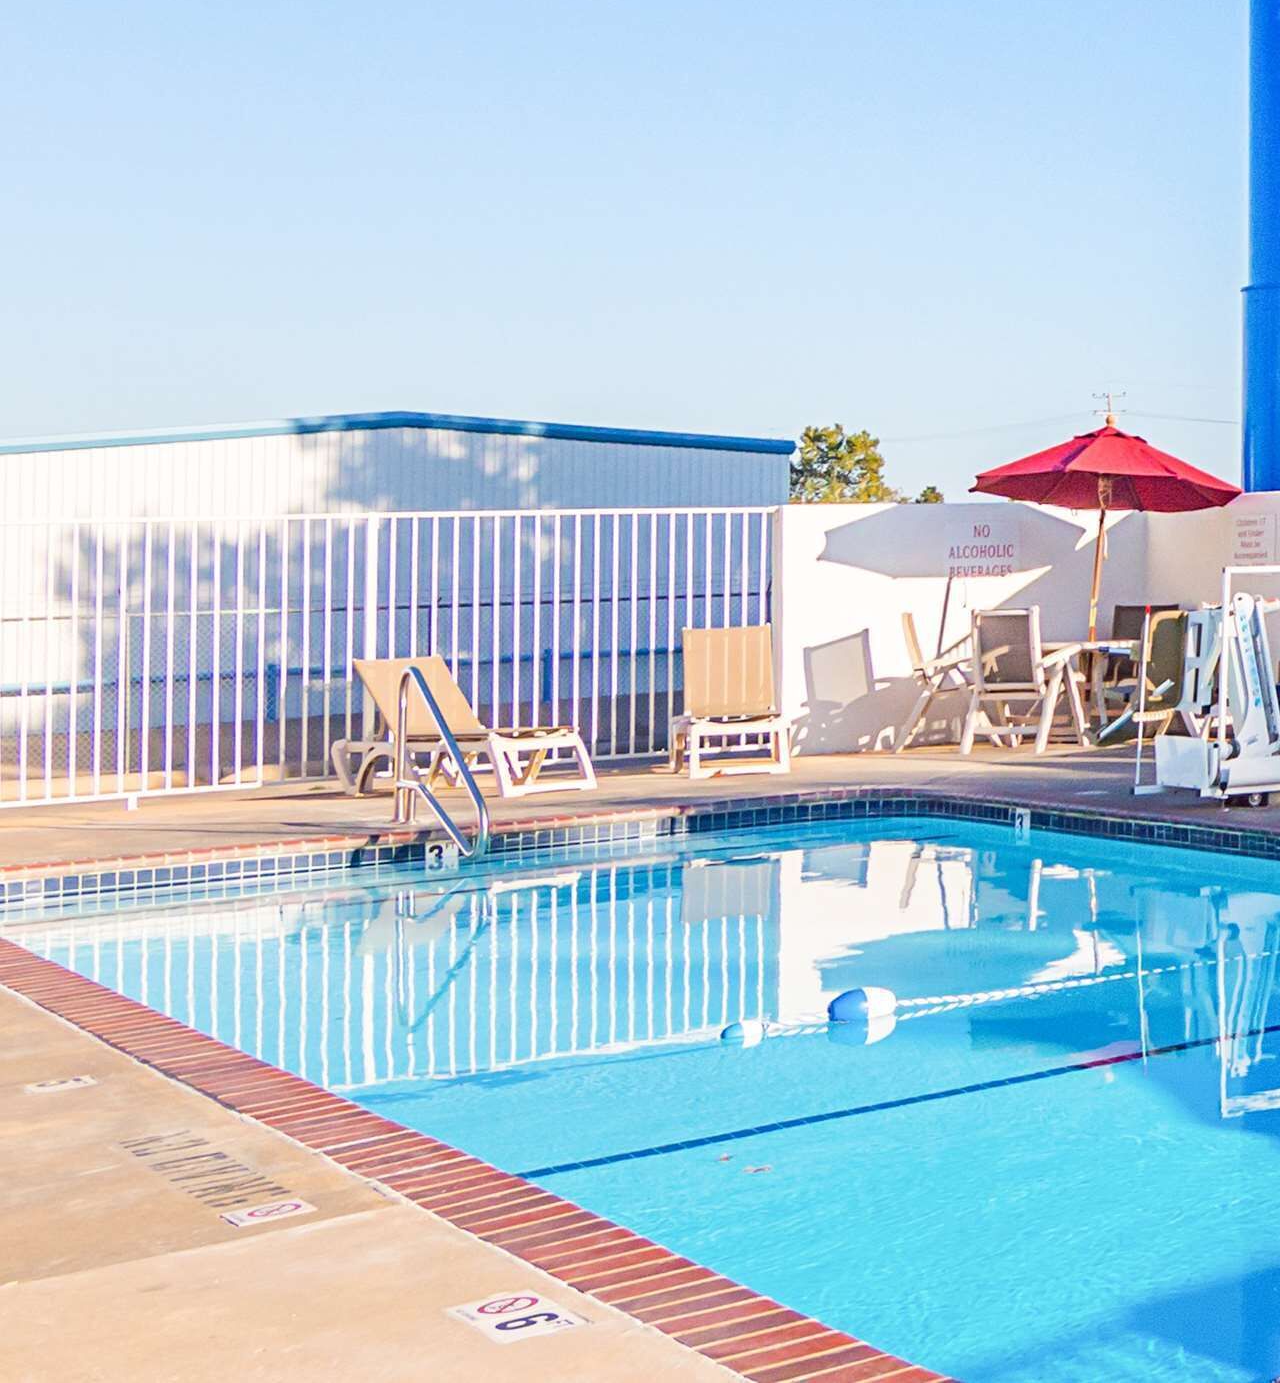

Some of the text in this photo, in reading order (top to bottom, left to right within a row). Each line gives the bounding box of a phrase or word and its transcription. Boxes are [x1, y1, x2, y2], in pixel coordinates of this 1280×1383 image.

[973, 524, 991, 538] NO
[948, 544, 1015, 559] ALCOHOLIC
[949, 564, 1013, 578] BEVERAGES
[495, 1313, 559, 1331] 6
